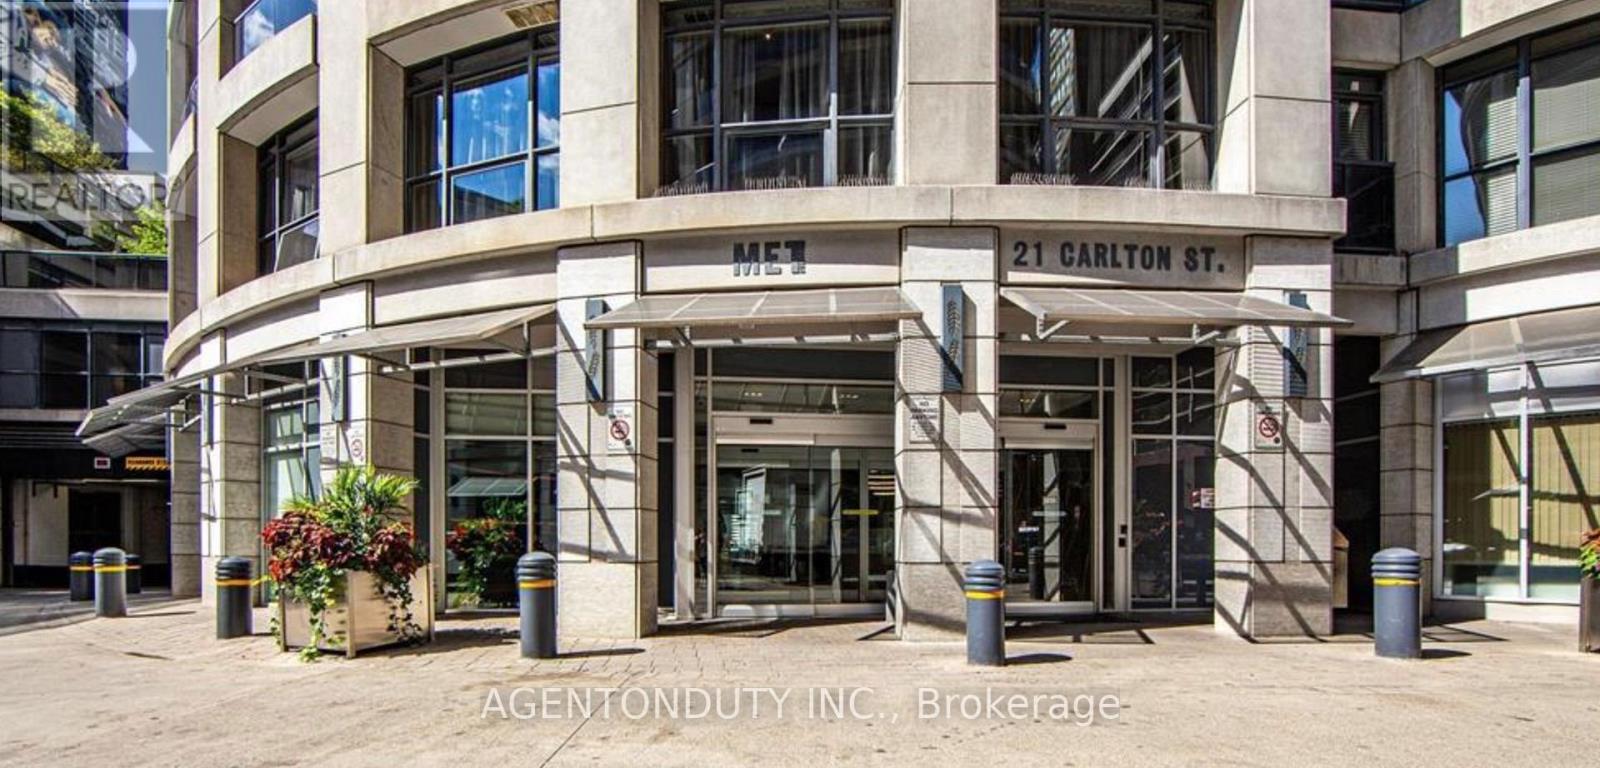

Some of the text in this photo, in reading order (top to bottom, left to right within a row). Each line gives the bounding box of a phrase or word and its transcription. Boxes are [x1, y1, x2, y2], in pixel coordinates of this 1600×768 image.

[1013, 240, 1225, 272] 21 CARLTON ST.
